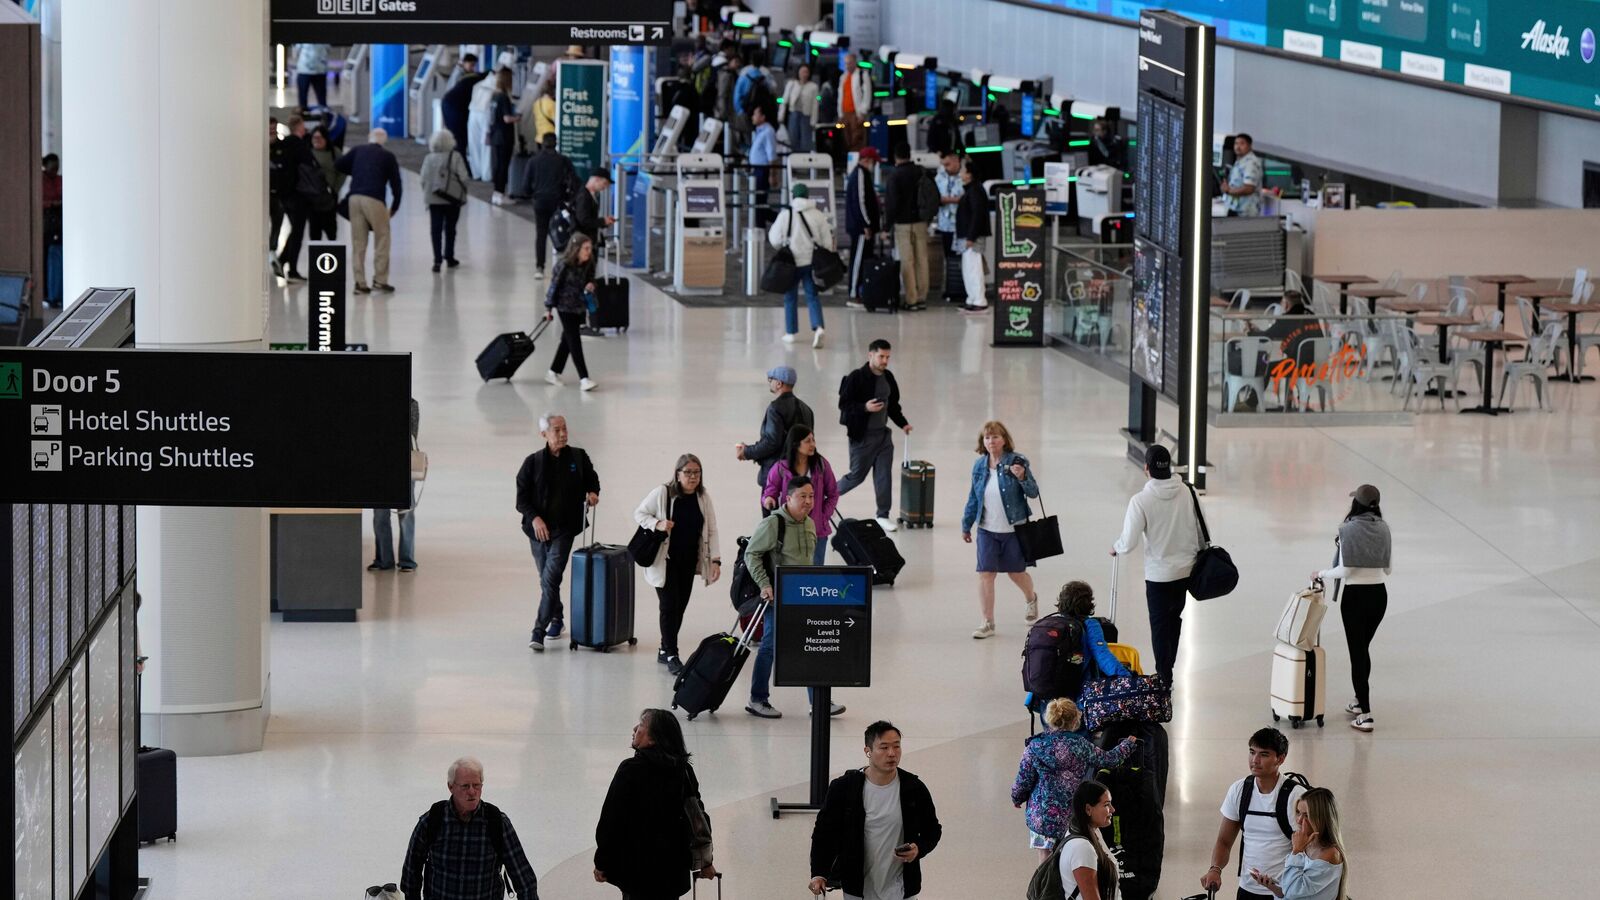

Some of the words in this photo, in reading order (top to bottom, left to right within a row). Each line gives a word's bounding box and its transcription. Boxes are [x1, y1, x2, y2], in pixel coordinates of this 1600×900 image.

[321, 0, 332, 10] D
[342, 0, 351, 10] E
[361, 0, 370, 11] F
[379, 0, 417, 11] Gates
[570, 26, 628, 39] Restrooms
[1521, 19, 1568, 60] Alaska
[562, 88, 588, 101] First
[562, 101, 594, 114] Class
[561, 114, 571, 127] &
[573, 115, 599, 128] Elite
[1018, 205, 1042, 213] LUNCH
[32, 368, 98, 393] Door
[104, 369, 121, 393] 5
[68, 409, 129, 431] Hotel
[135, 410, 231, 432] Shuttles
[69, 445, 152, 472] Parking
[159, 446, 254, 468] Shuttles
[799, 586, 819, 597] TSA
[821, 586, 839, 597] Pre
[806, 618, 833, 626] Proceed
[804, 644, 840, 652] Checkpoint
